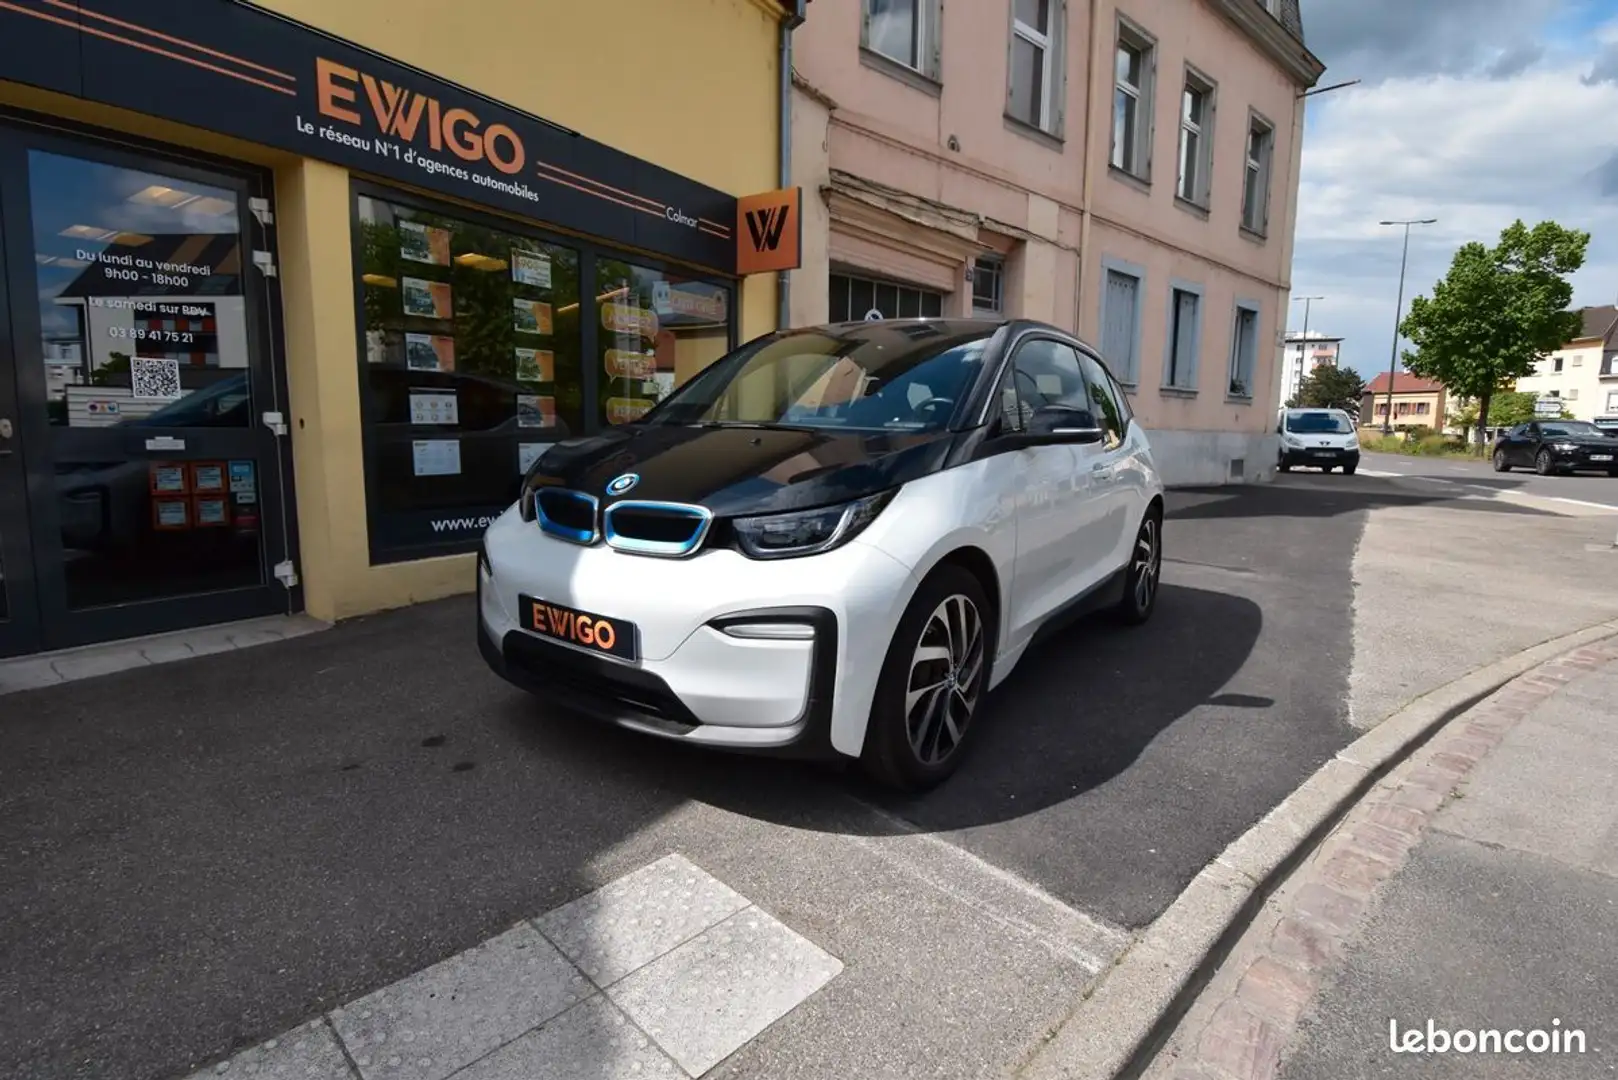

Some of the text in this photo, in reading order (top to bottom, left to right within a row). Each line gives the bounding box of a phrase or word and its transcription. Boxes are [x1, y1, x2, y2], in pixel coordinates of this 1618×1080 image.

[316, 56, 526, 175] EWIGO
[296, 115, 539, 202] Le réseau N°1 d'agences automobiles
[666, 206, 698, 228] Colmar
[76, 249, 211, 276] Du lundi au vendredi
[104, 267, 139, 281] 9h00
[152, 273, 189, 287] 18h00
[88, 296, 103, 307] Le
[106, 298, 157, 312] samedi
[159, 305, 179, 315] sur
[109, 327, 193, 343] 03 89 41 75 21
[431, 511, 503, 532] www.e
[532, 602, 616, 649] EWIGO
